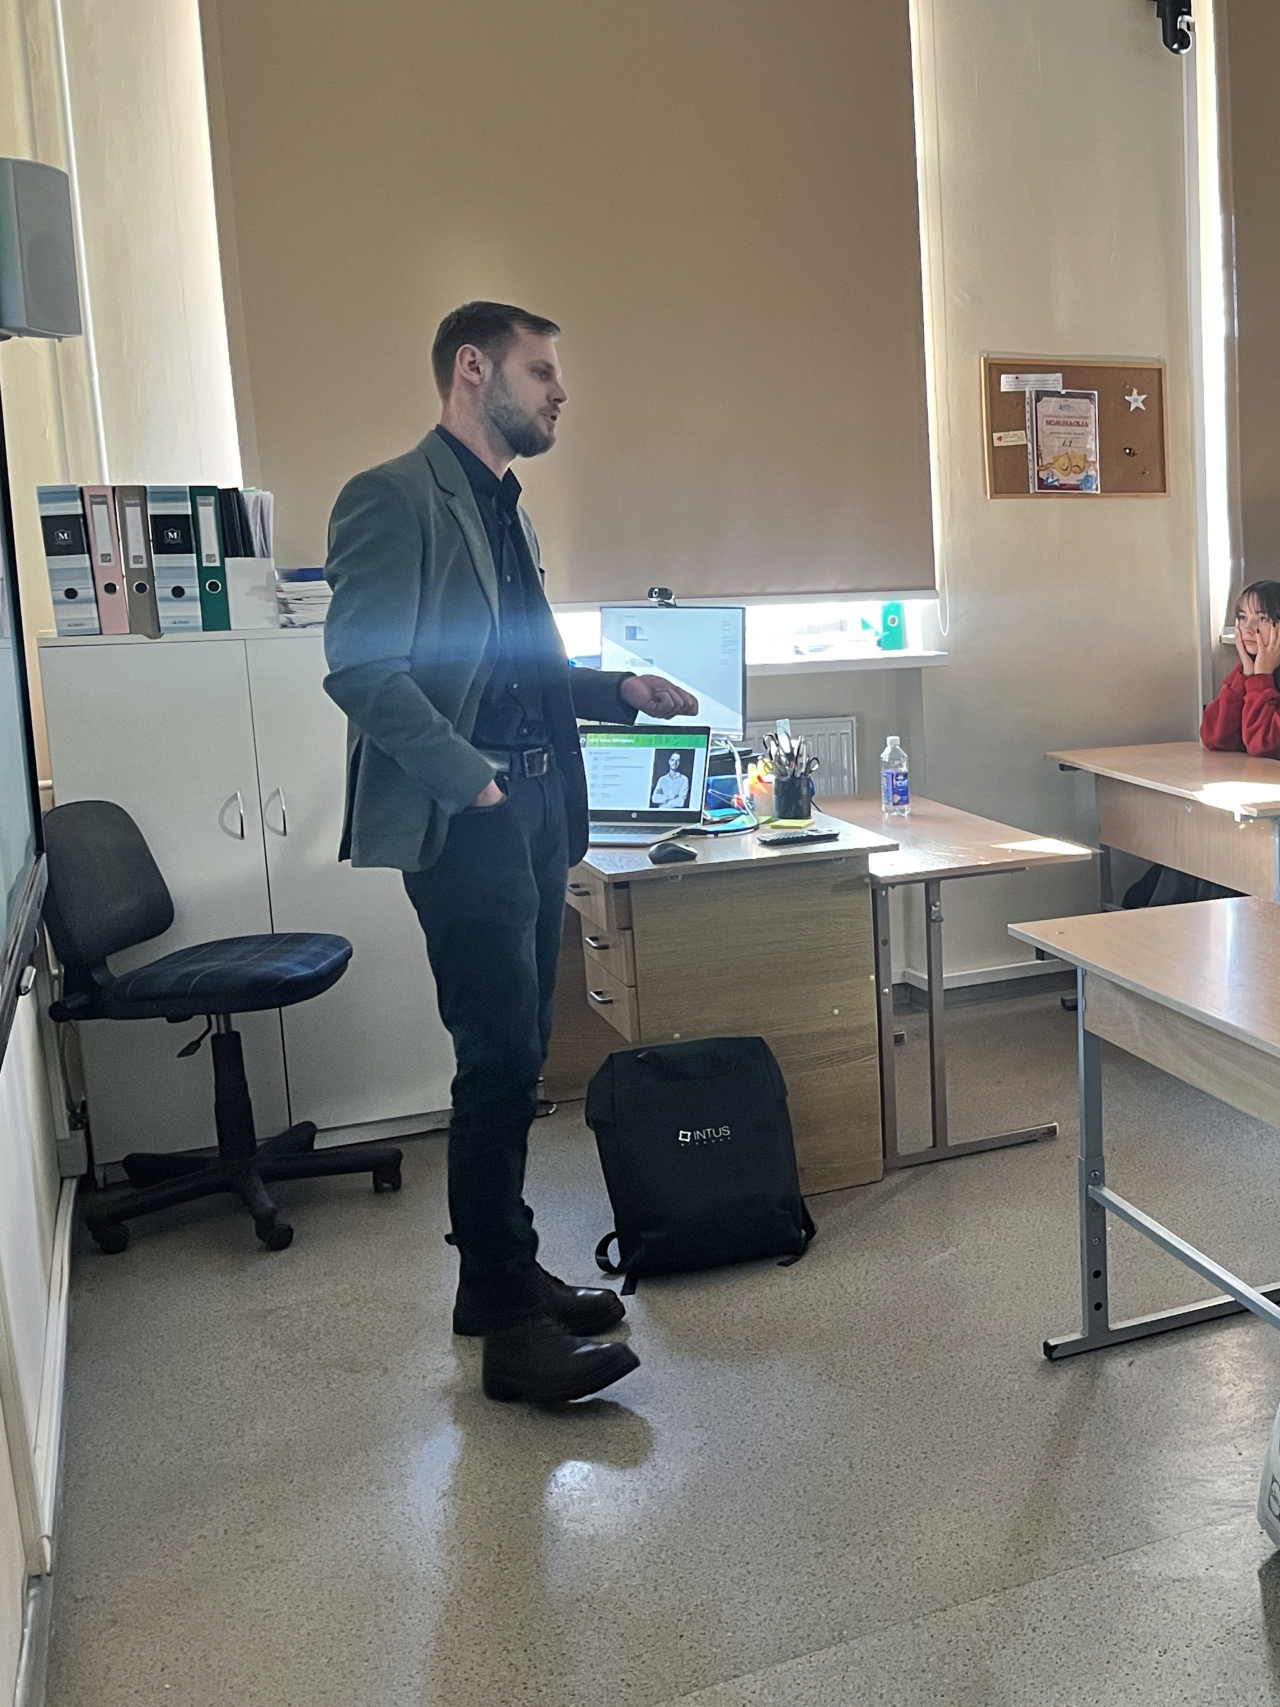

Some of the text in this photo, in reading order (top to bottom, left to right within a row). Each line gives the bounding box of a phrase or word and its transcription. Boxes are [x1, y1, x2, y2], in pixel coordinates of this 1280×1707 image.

[58, 532, 69, 540] M
[167, 532, 178, 540] M
[693, 1126, 731, 1140] INTUS
